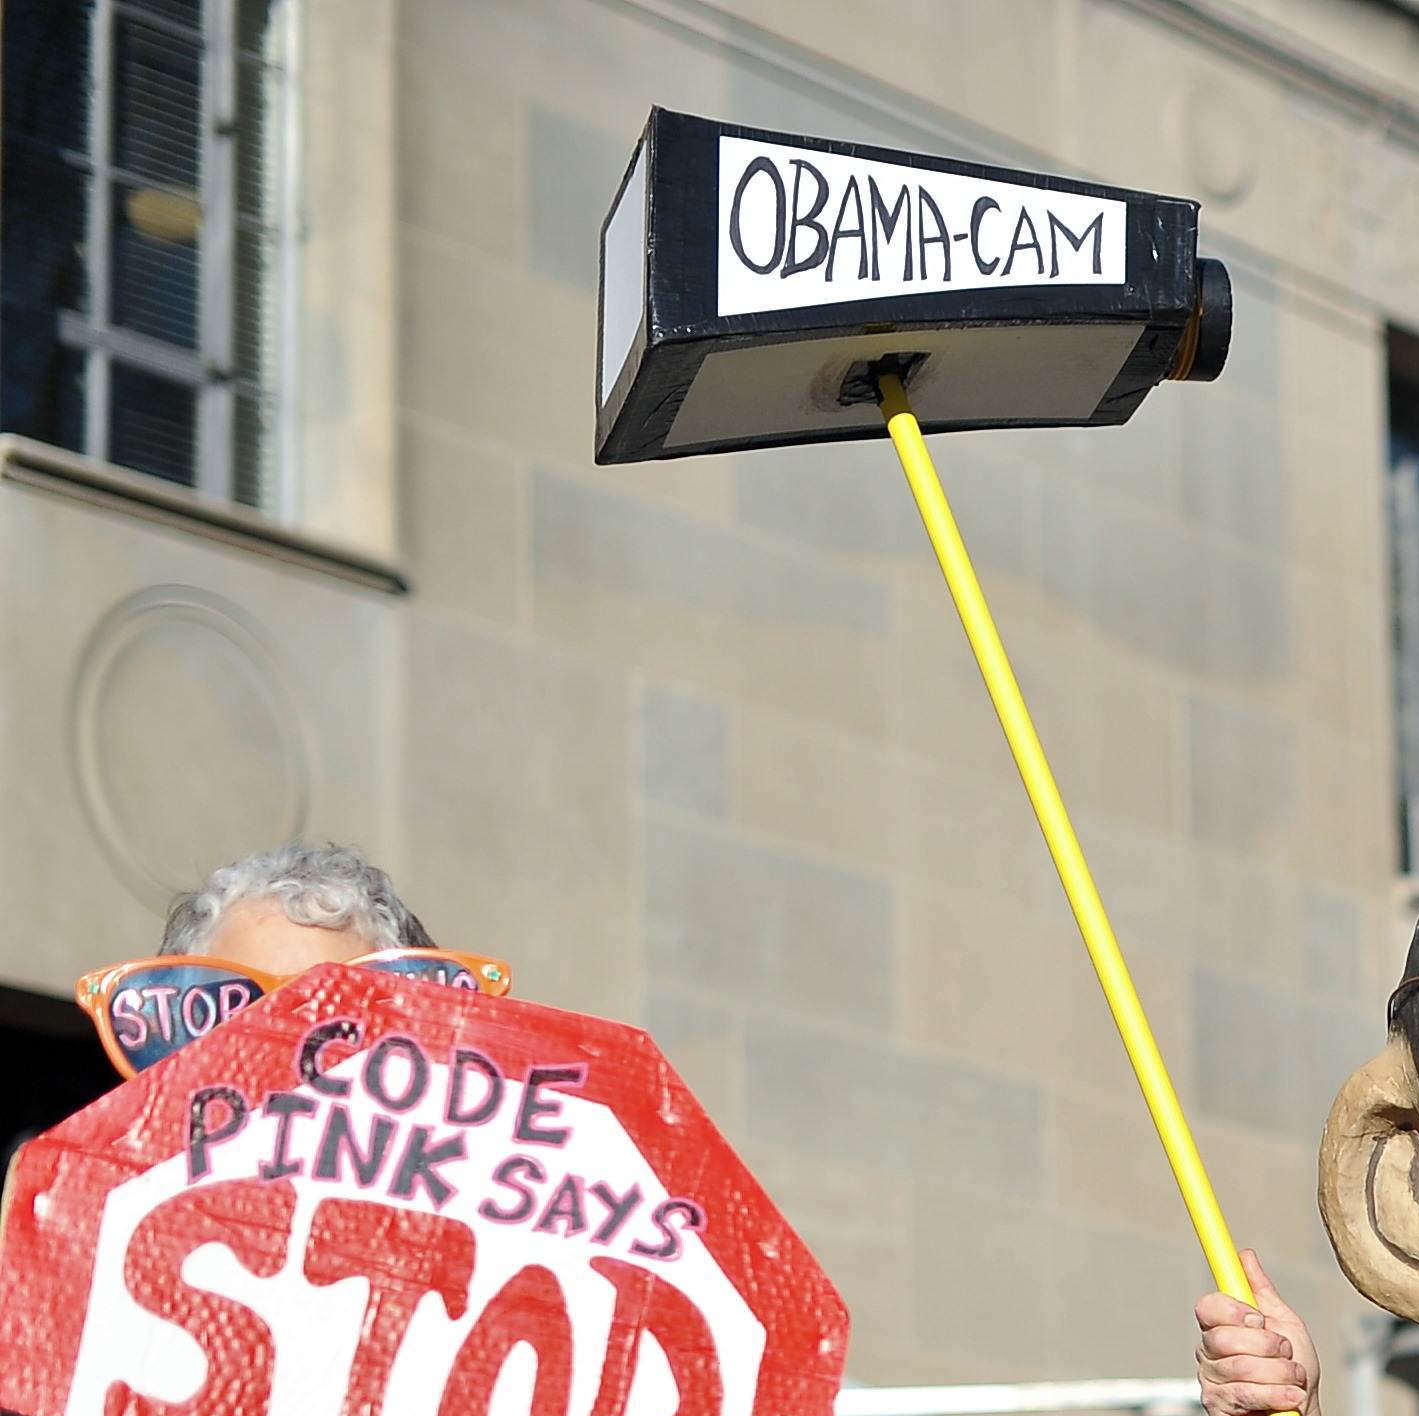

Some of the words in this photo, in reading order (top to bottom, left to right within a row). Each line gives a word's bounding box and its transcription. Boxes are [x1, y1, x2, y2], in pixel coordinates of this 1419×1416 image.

[729, 157, 1104, 283] OBAMA-CAM
[298, 1018, 587, 1152] CODE
[185, 1086, 475, 1206] PINK
[479, 1155, 706, 1262] SAYS
